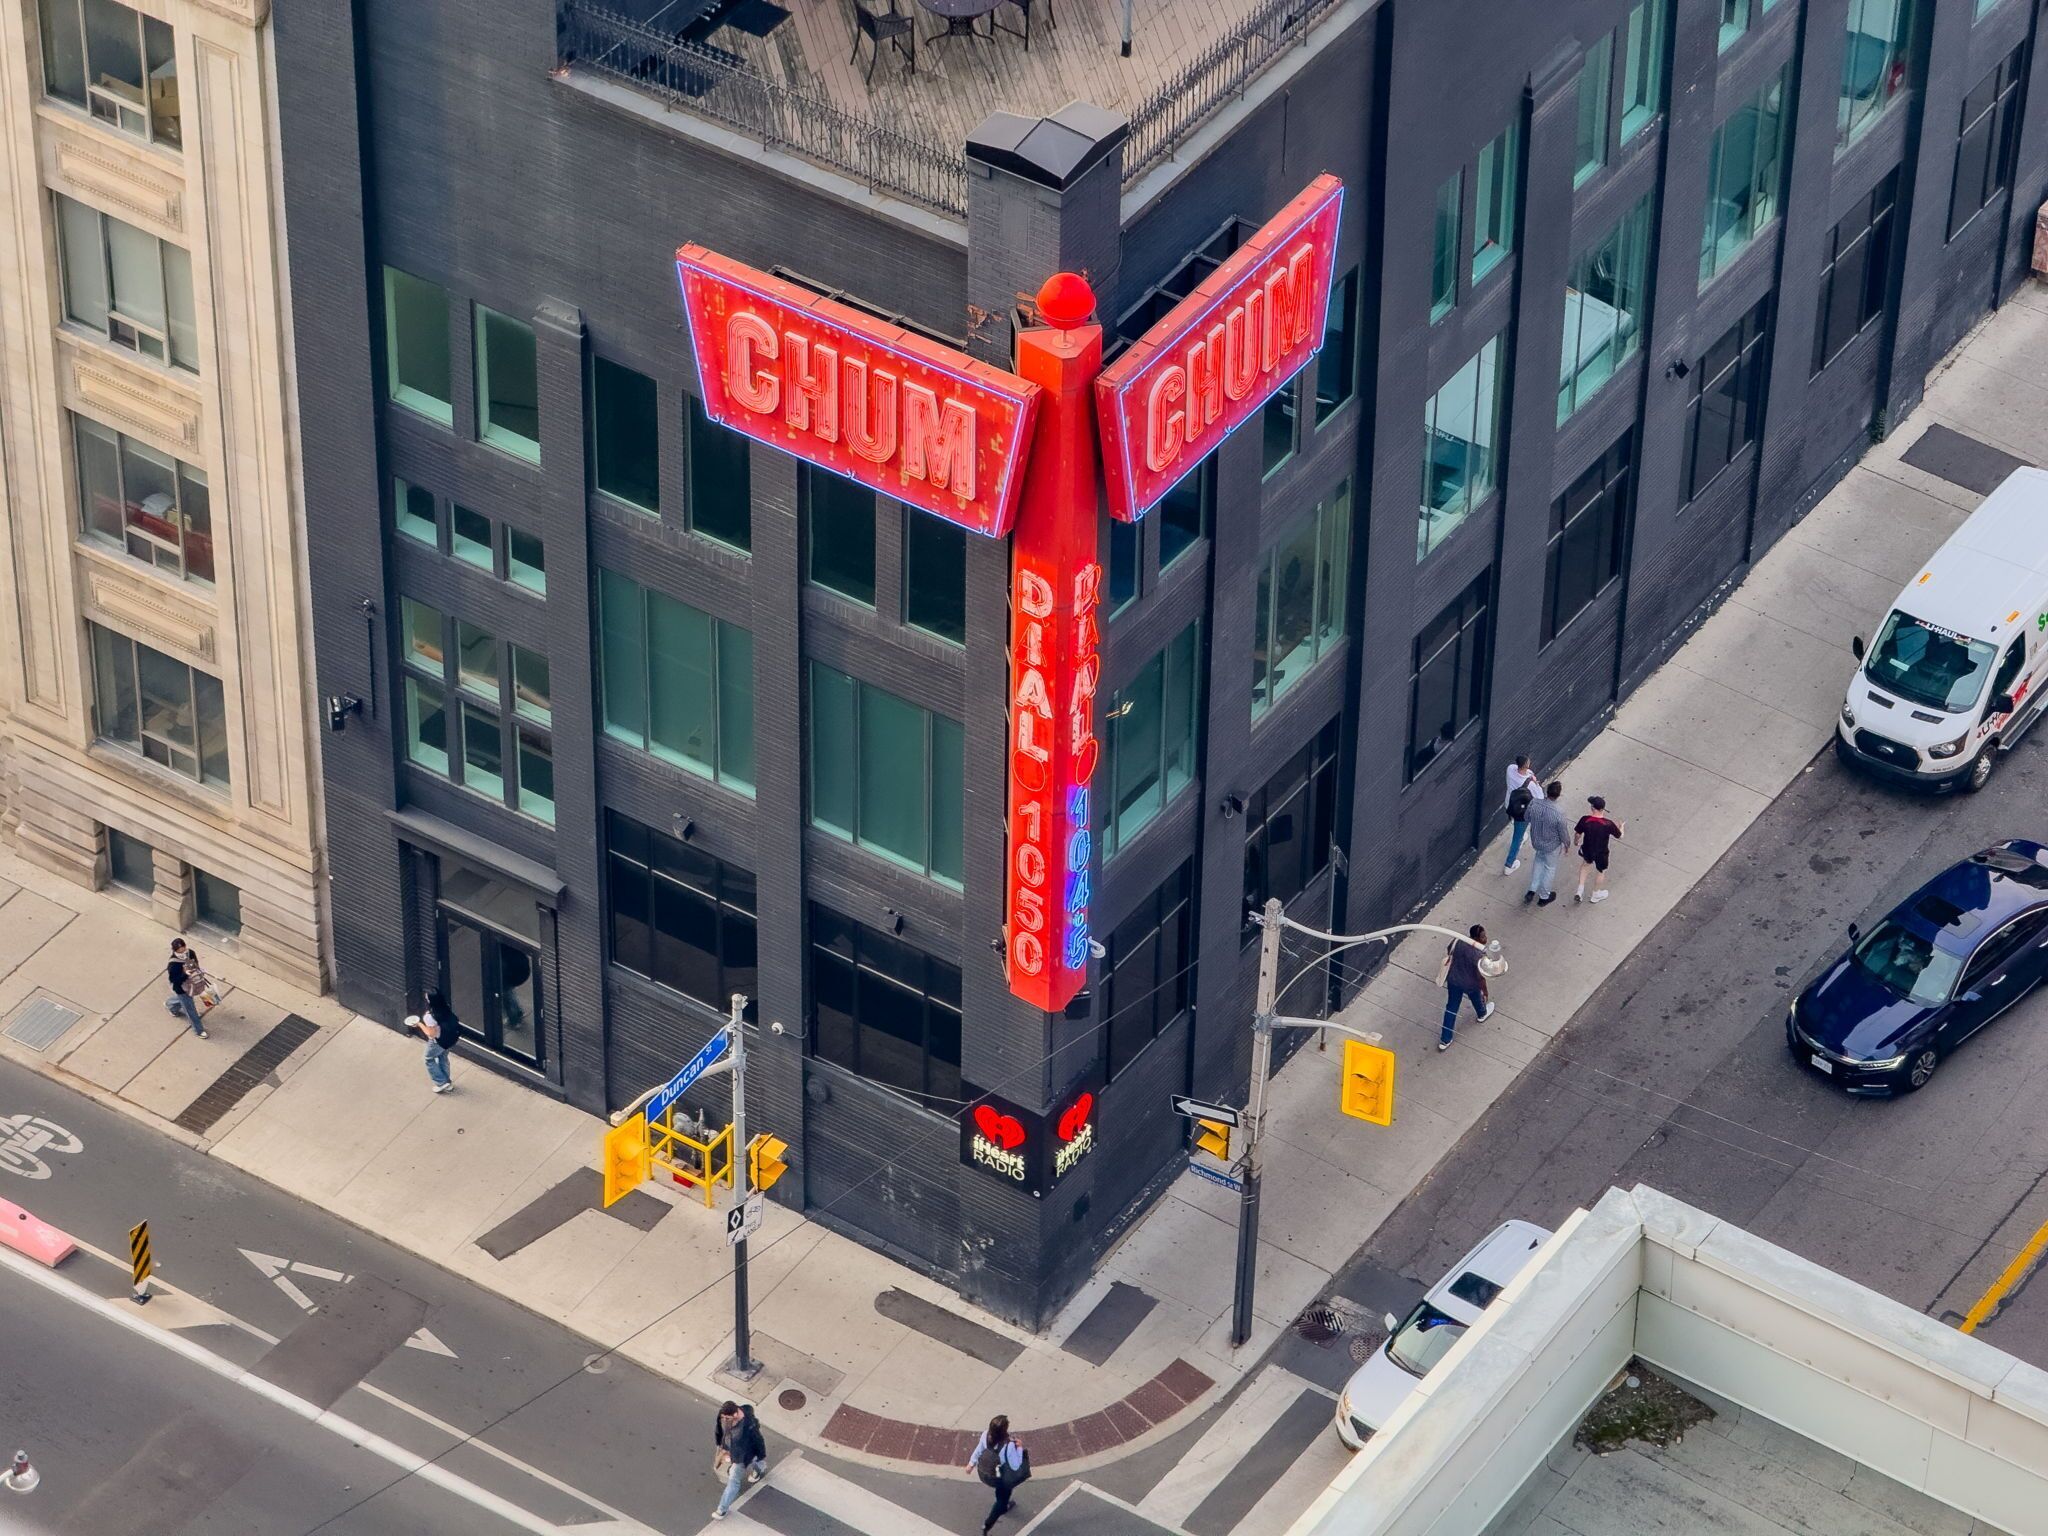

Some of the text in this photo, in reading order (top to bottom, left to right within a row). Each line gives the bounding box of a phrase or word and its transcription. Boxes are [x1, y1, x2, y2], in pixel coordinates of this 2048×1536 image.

[1146, 242, 1314, 472] CHUM
[726, 311, 977, 501] CHUM
[1926, 622, 1959, 640] U-HAUL
[1013, 568, 1053, 977] DIAL 1050
[1067, 785, 1091, 971] 104.5
[661, 1045, 712, 1106] Duncan St
[973, 1134, 1025, 1171] iHeart
[973, 1149, 1025, 1181] RADIO
[1056, 1123, 1092, 1166] iHeart
[1056, 1136, 1092, 1178] RADIO
[1190, 1164, 1227, 1186] Richmond
[1233, 1183, 1241, 1192] W
